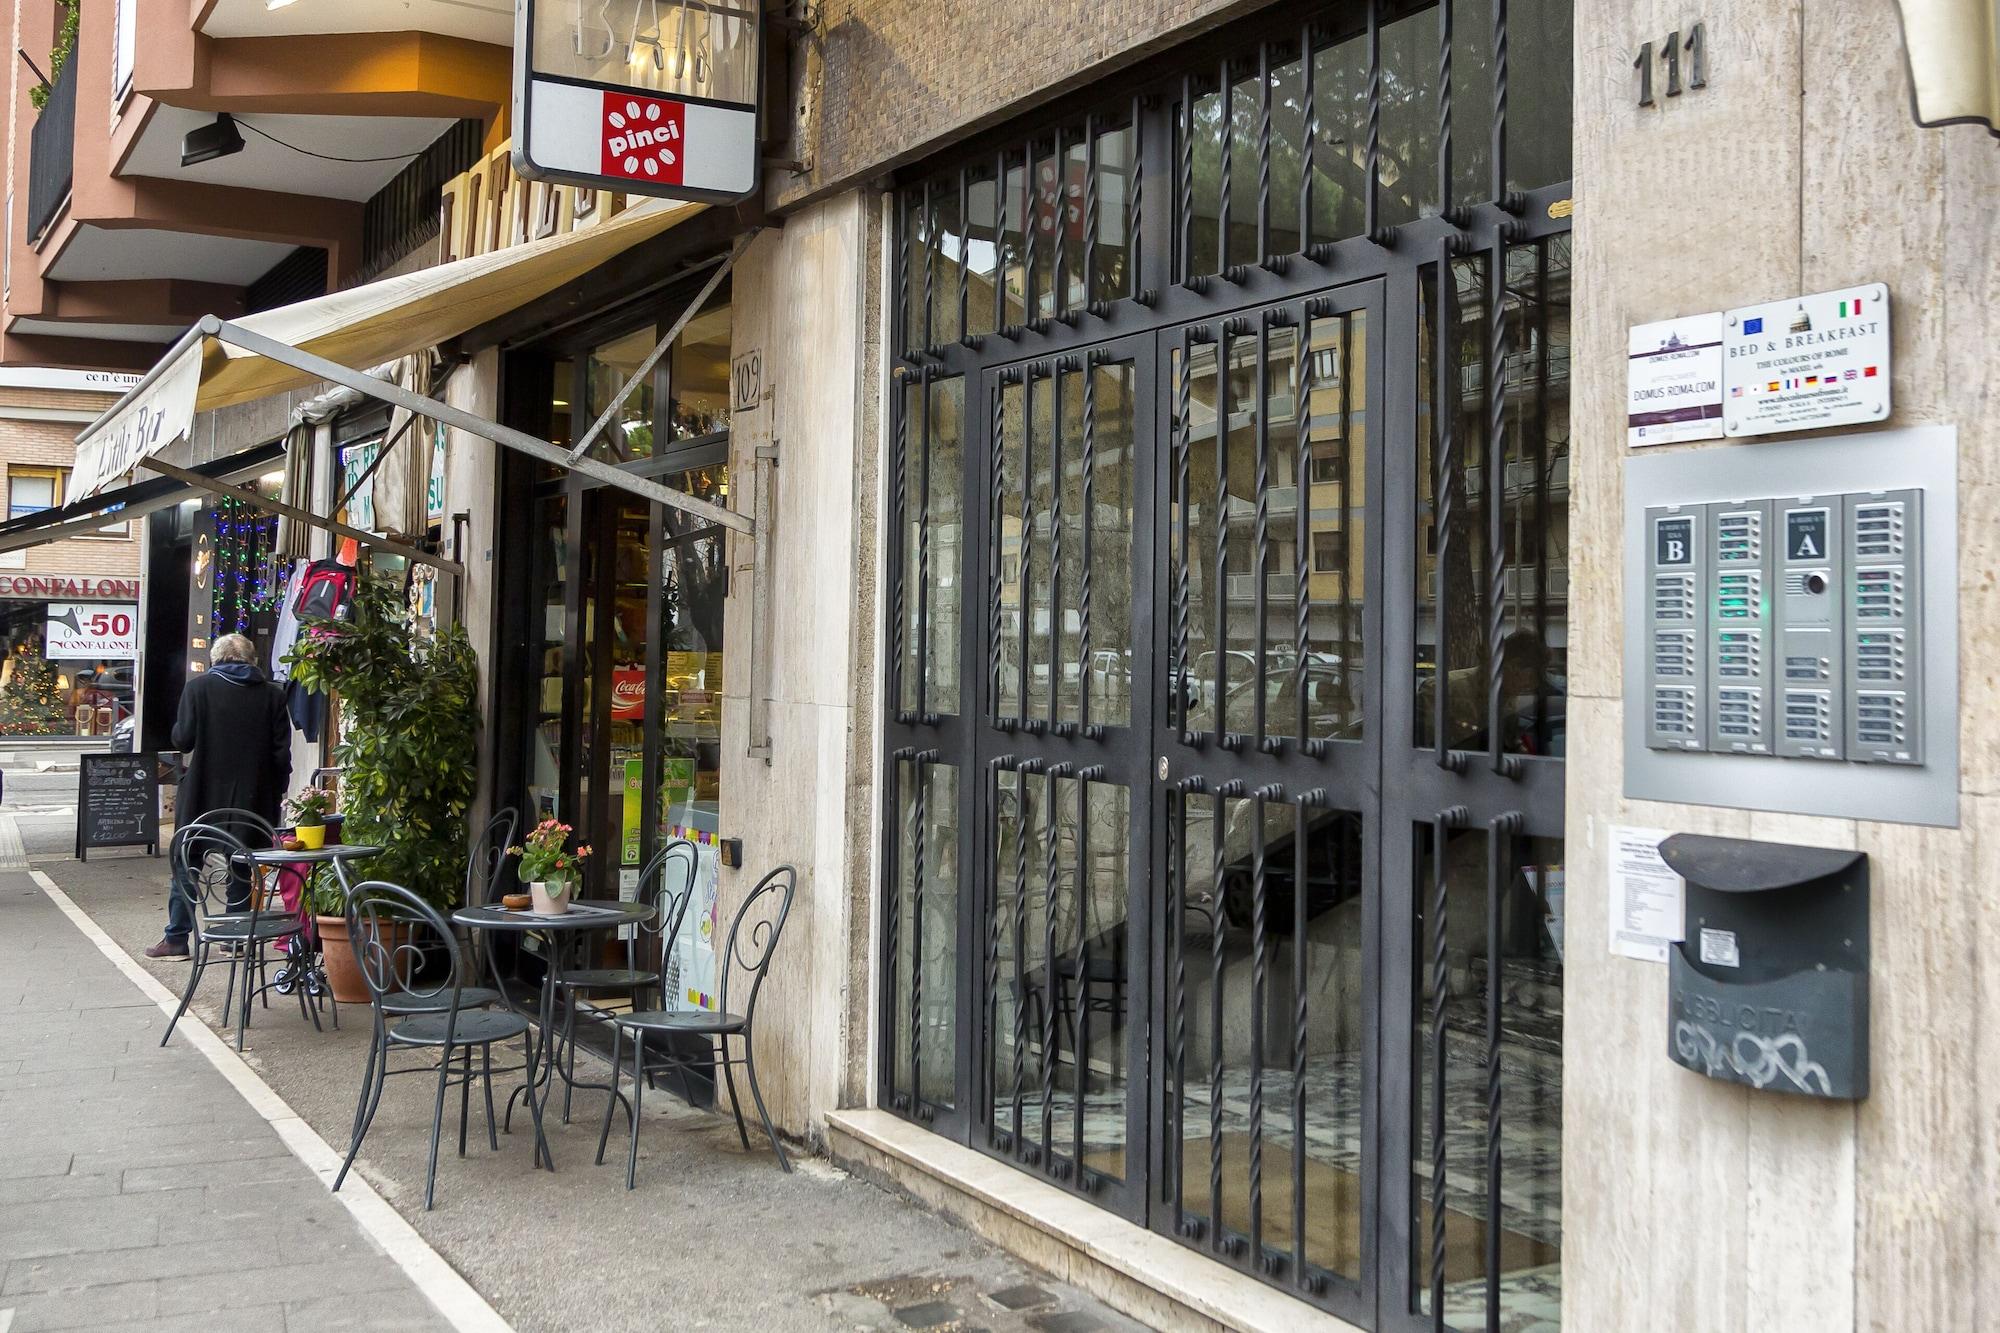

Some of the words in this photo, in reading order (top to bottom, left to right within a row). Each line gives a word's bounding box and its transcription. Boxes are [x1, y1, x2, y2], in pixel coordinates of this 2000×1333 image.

[1633, 23, 1707, 107] 111
[608, 120, 680, 157] pinci
[1730, 344, 1759, 358] BED
[1766, 341, 1777, 352] &
[1785, 322, 1879, 349] BREAKFAST
[734, 356, 759, 408] 109
[1634, 386, 1666, 402] DOMUS
[97, 423, 131, 478] Little
[1666, 540, 1684, 562] B
[1796, 534, 1819, 556] A
[63, 641, 133, 649] CONFALONE
